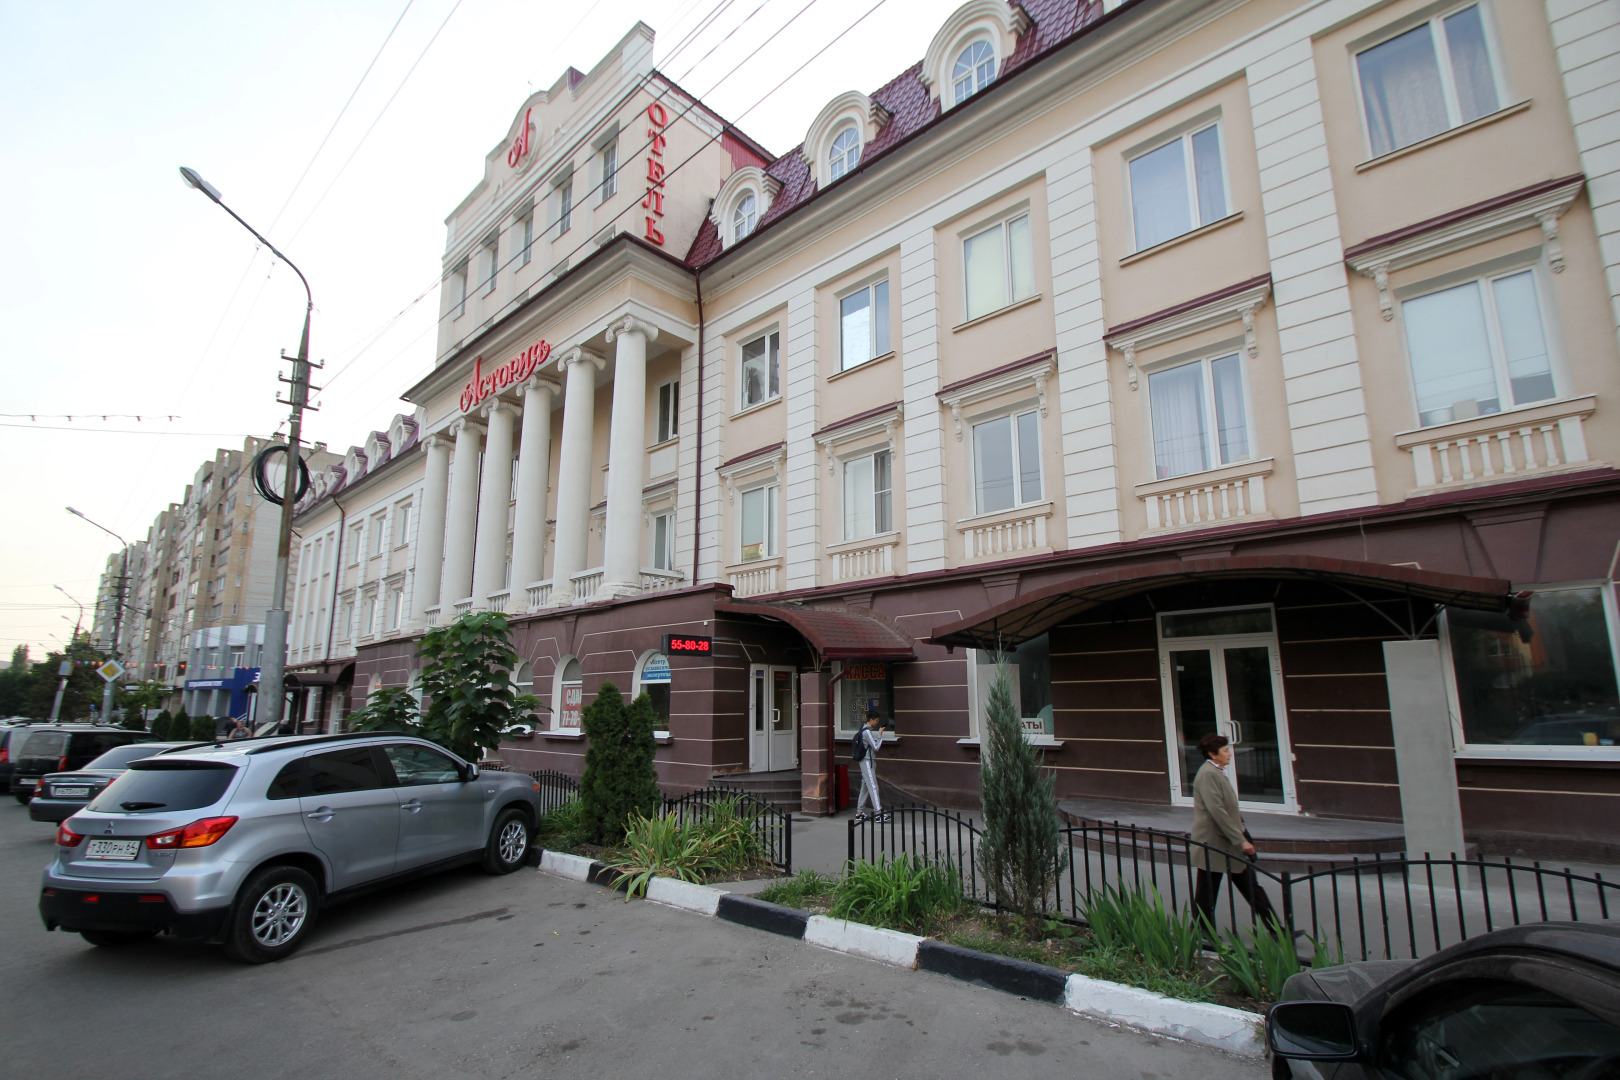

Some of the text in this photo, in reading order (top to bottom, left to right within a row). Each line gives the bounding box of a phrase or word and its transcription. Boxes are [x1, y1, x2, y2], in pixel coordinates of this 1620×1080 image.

[642, 103, 668, 245] ОТЕЛЬ
[671, 639, 710, 651] 55-80-28
[846, 663, 886, 680] КАССА
[562, 710, 581, 726] 77-70-
